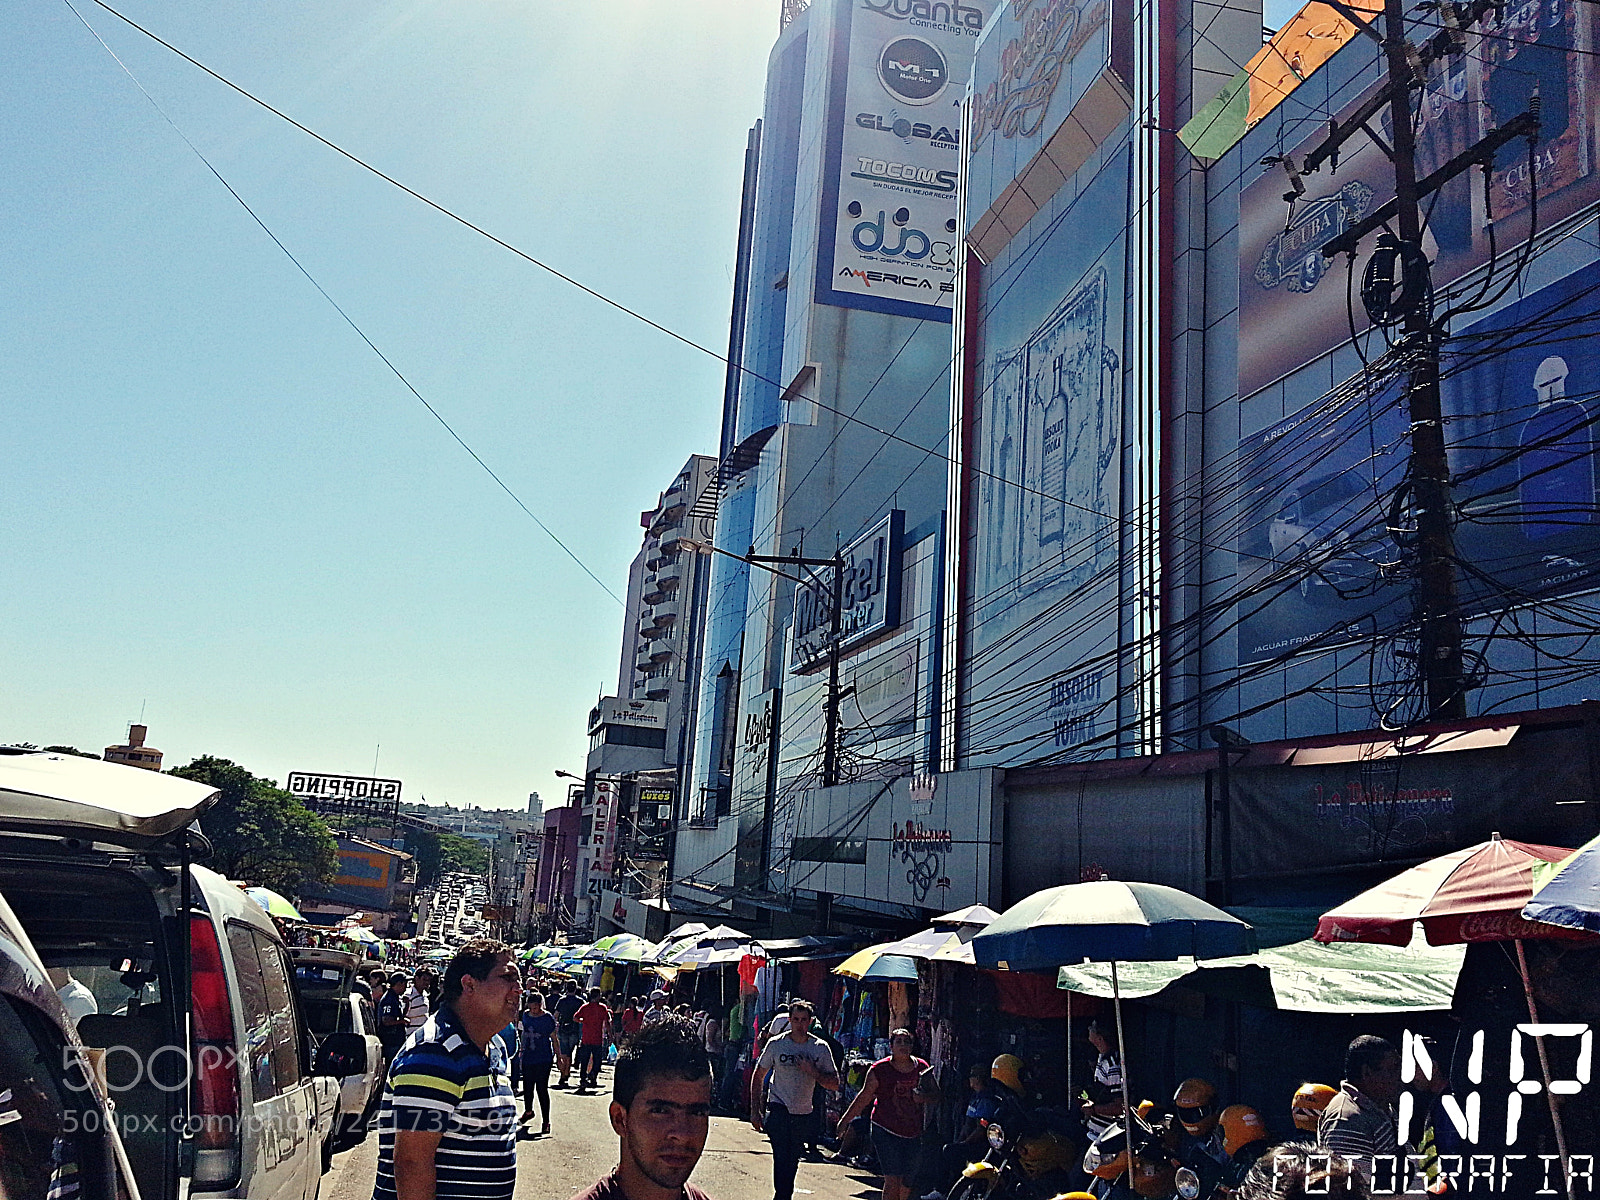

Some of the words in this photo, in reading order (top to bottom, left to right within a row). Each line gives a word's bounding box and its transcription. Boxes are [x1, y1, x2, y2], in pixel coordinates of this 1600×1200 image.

[863, 0, 982, 29] Quanta
[909, 17, 961, 36] Connecting
[918, 76, 931, 84] One
[883, 183, 904, 192] DUDAS
[913, 188, 933, 197] MEJOR
[1290, 211, 1332, 251] CUBA
[839, 266, 932, 290] AMERICA
[1251, 640, 1288, 654] JAGUAR
[1049, 670, 1103, 708] ABSOLUT
[590, 782, 609, 872] GALERIA
